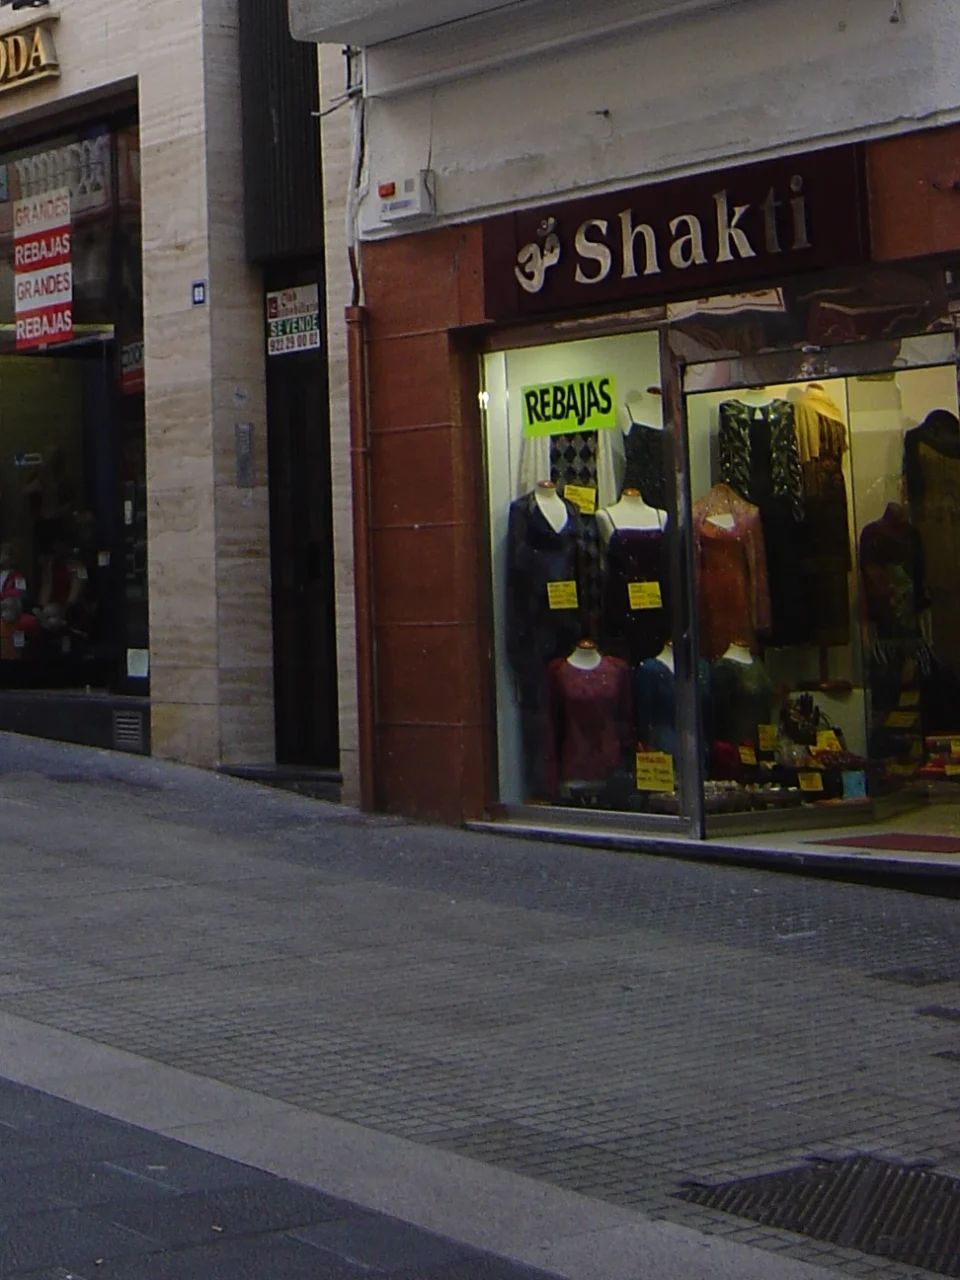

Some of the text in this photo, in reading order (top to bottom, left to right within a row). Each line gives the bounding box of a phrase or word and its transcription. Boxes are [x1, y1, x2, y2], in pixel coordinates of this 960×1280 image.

[14, 194, 69, 228] GRANDES
[574, 174, 812, 285] Shakti
[14, 232, 71, 266] REBAJAS
[16, 272, 71, 302] GRANDES
[15, 308, 73, 341] REBAJAS
[524, 377, 613, 426] REBAJAS
